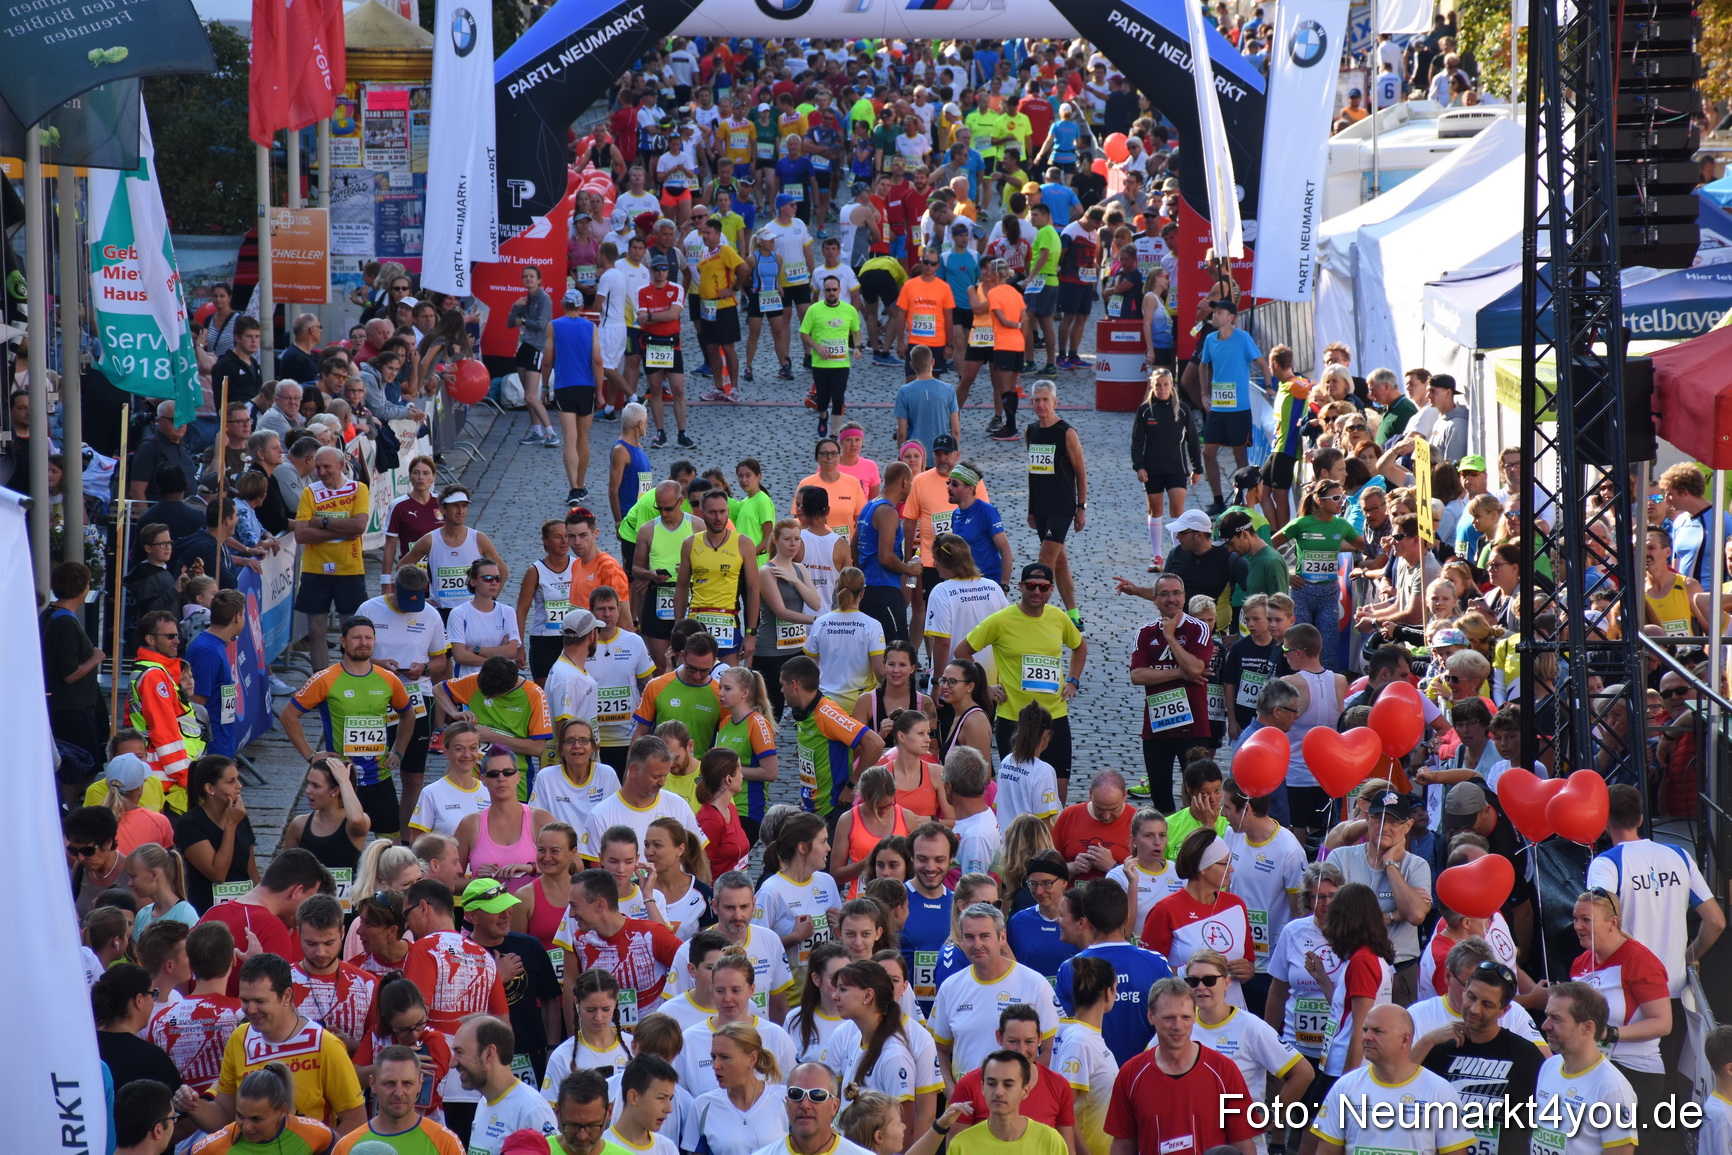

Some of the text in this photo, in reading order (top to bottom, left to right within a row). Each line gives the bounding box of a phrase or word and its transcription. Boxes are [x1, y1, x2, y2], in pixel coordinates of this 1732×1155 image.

[1107, 9, 1162, 55] PARTL
[507, 4, 647, 99] PARTL NEUMARKT
[1384, 83, 1394, 100] 6
[1298, 179, 1316, 294] PARTL NEUMARKT
[513, 255, 553, 266] Laufsport
[454, 247, 467, 288] PARTL
[788, 267, 806, 276] 2817
[1685, 272, 1713, 281] Hier
[913, 321, 933, 330] 2753
[974, 333, 994, 342] 1303
[650, 352, 671, 361] 1297
[1214, 390, 1234, 400] 1160
[1030, 455, 1051, 464] 1126
[1420, 470, 1430, 521] A
[1304, 552, 1338, 561] BOCK
[1305, 561, 1335, 573] 2348
[959, 585, 996, 595] Neumarkter
[960, 593, 990, 603] Stadtlauf
[828, 620, 866, 628] Neumarkter
[826, 628, 857, 636] Stadtlauf
[1025, 655, 1059, 668] BOCK
[1027, 666, 1057, 681] 2831
[1149, 691, 1184, 706] BOCK
[1152, 701, 1186, 720] 2786
[347, 716, 384, 728] BOCK
[819, 704, 857, 733] BOCK
[1157, 714, 1188, 728] MAREK
[349, 730, 384, 743] 5142
[1042, 791, 1057, 805] 20
[999, 992, 1010, 1002] 20
[1064, 1060, 1081, 1073] 20
[1447, 1055, 1514, 1080] PUMA
